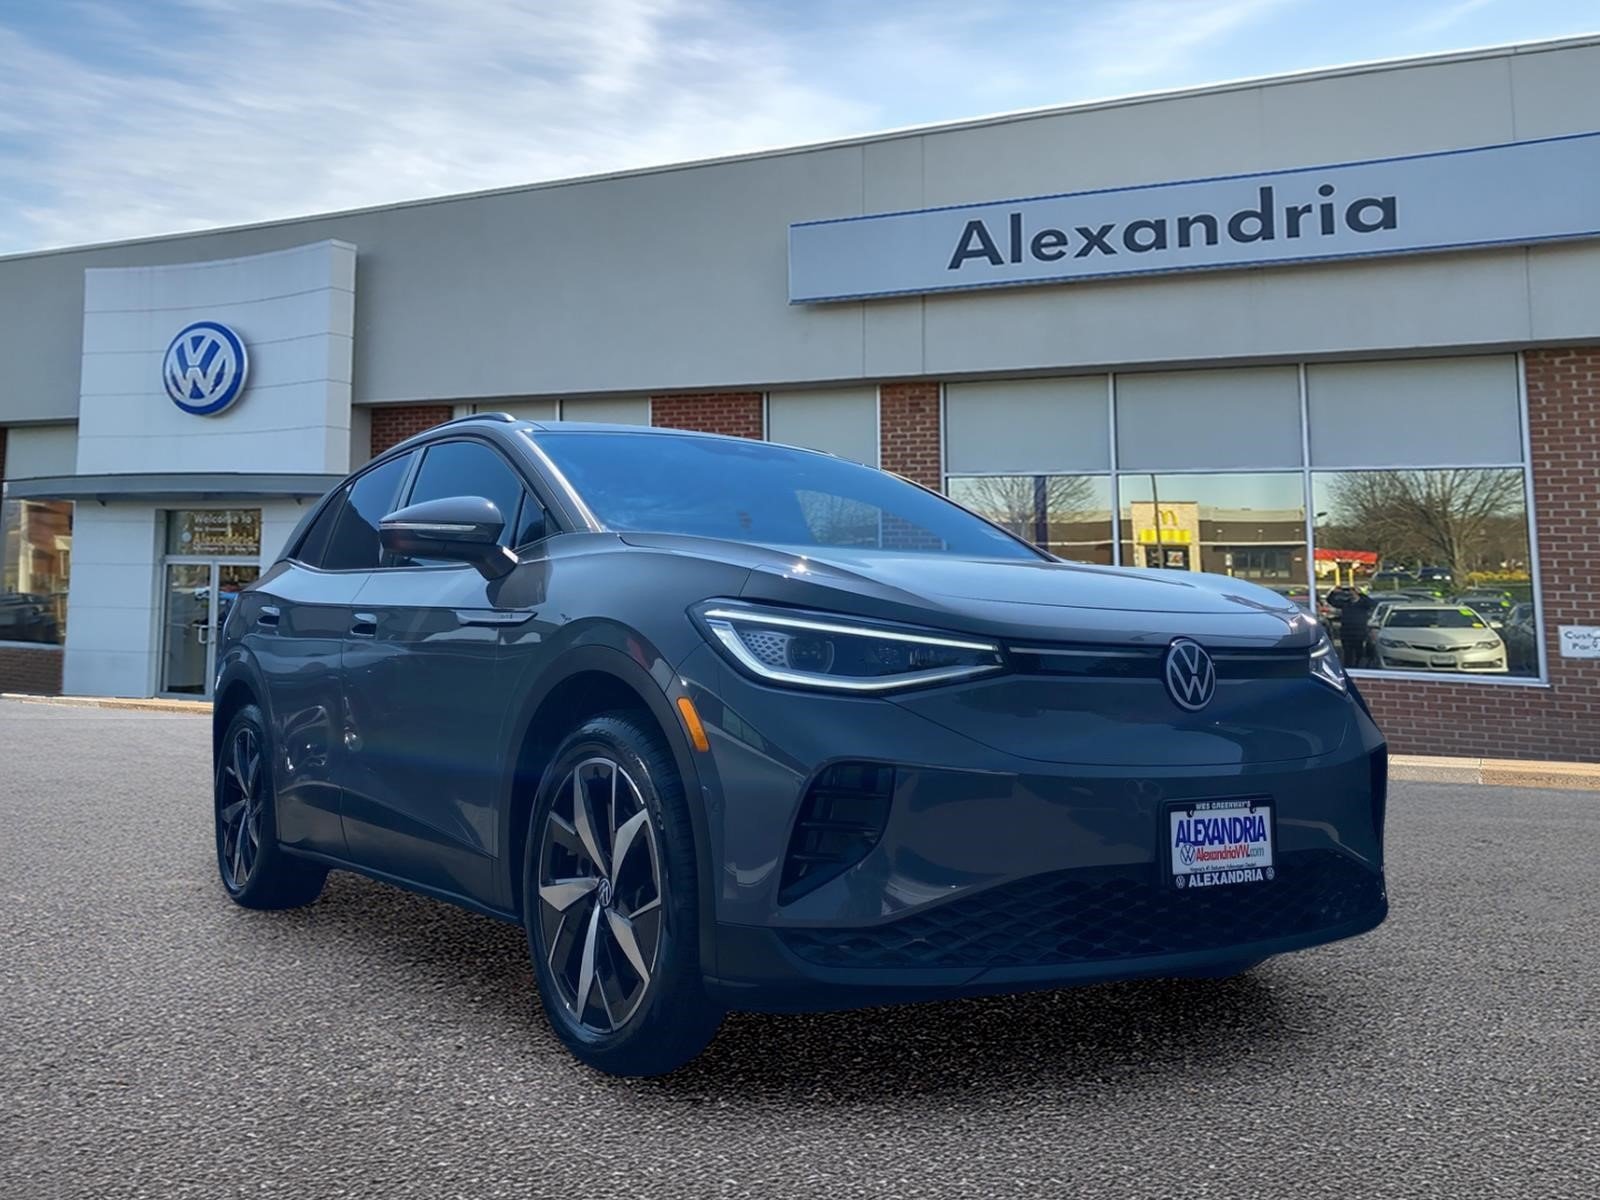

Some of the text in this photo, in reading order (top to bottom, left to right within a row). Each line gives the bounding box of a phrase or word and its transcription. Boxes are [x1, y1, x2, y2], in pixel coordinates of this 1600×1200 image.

[947, 184, 1397, 270] Alexandria
[1175, 815, 1267, 848] ALEXANDRIA
[1196, 844, 1265, 862] AlexandriaVW.com
[1189, 868, 1264, 888] ALEXANDRIA
